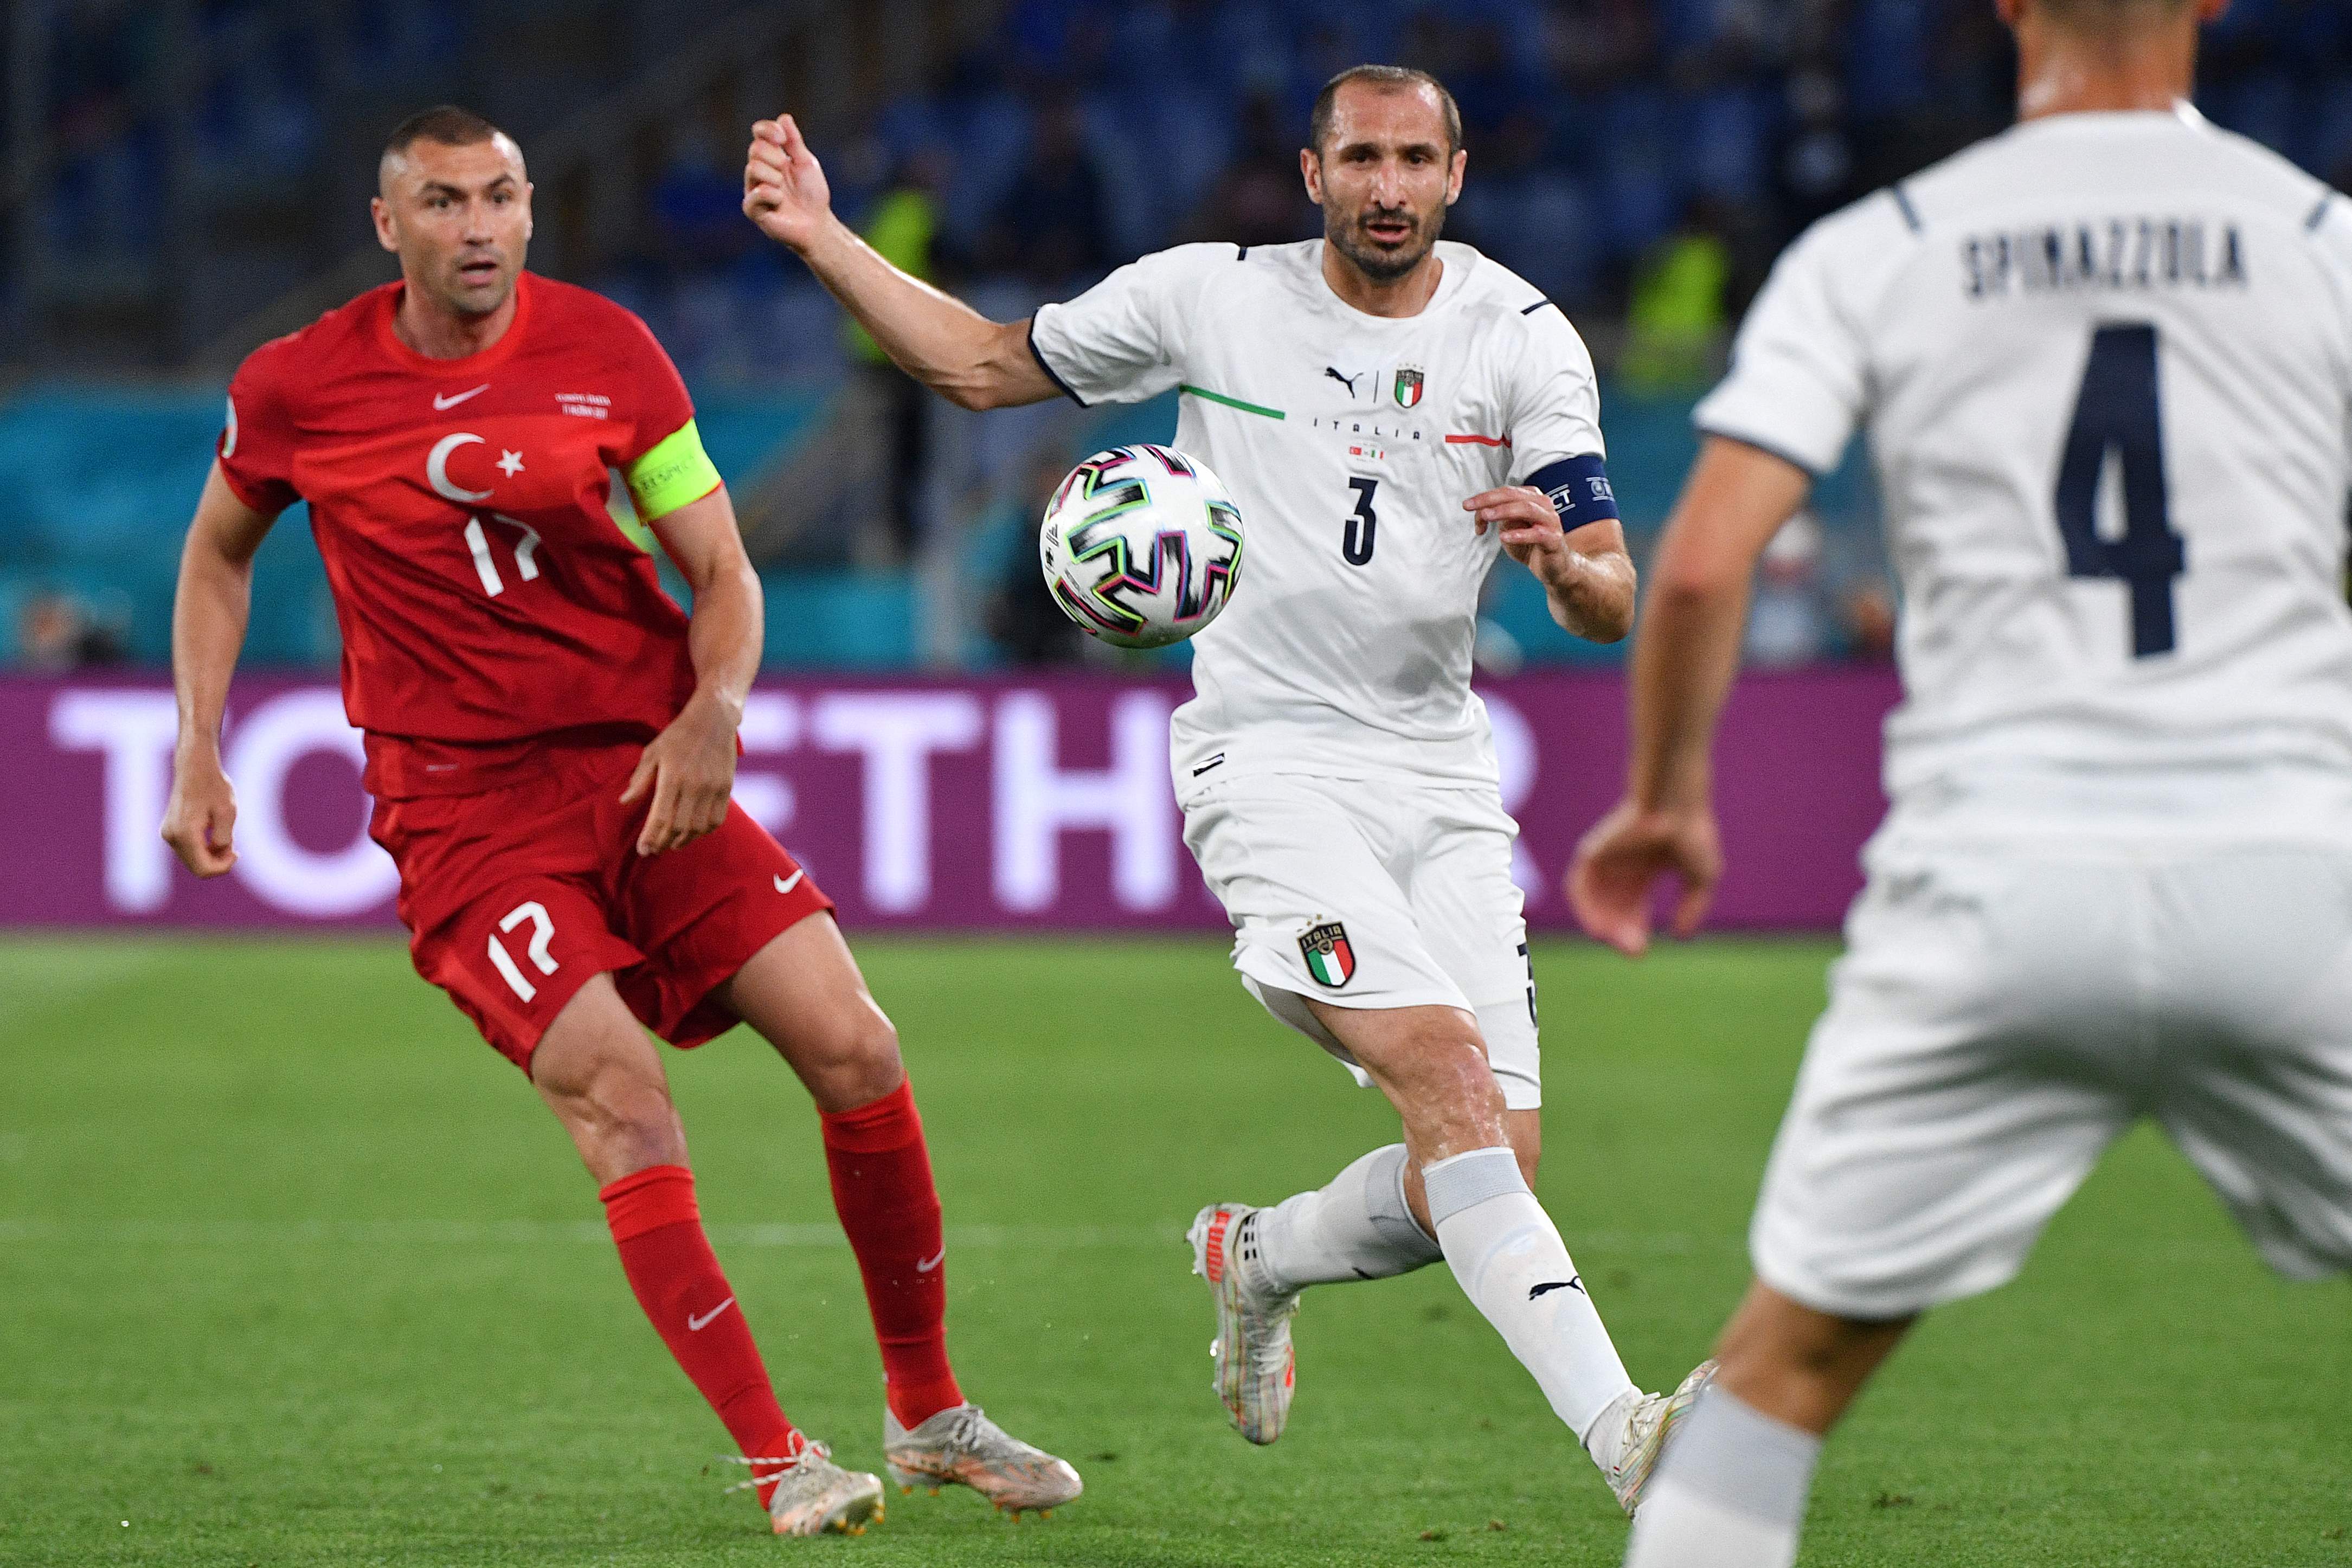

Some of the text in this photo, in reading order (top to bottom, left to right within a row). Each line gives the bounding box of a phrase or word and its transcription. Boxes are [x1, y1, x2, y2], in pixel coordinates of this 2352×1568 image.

[1964, 218, 2248, 299] SPINAZZOLA
[1313, 417, 1421, 440] ITALIA
[1343, 477, 1379, 566] 3
[2053, 321, 2187, 659] 4
[464, 515, 541, 597] 17
[488, 901, 559, 1003] 17
[1301, 924, 1342, 949] ITALIA
